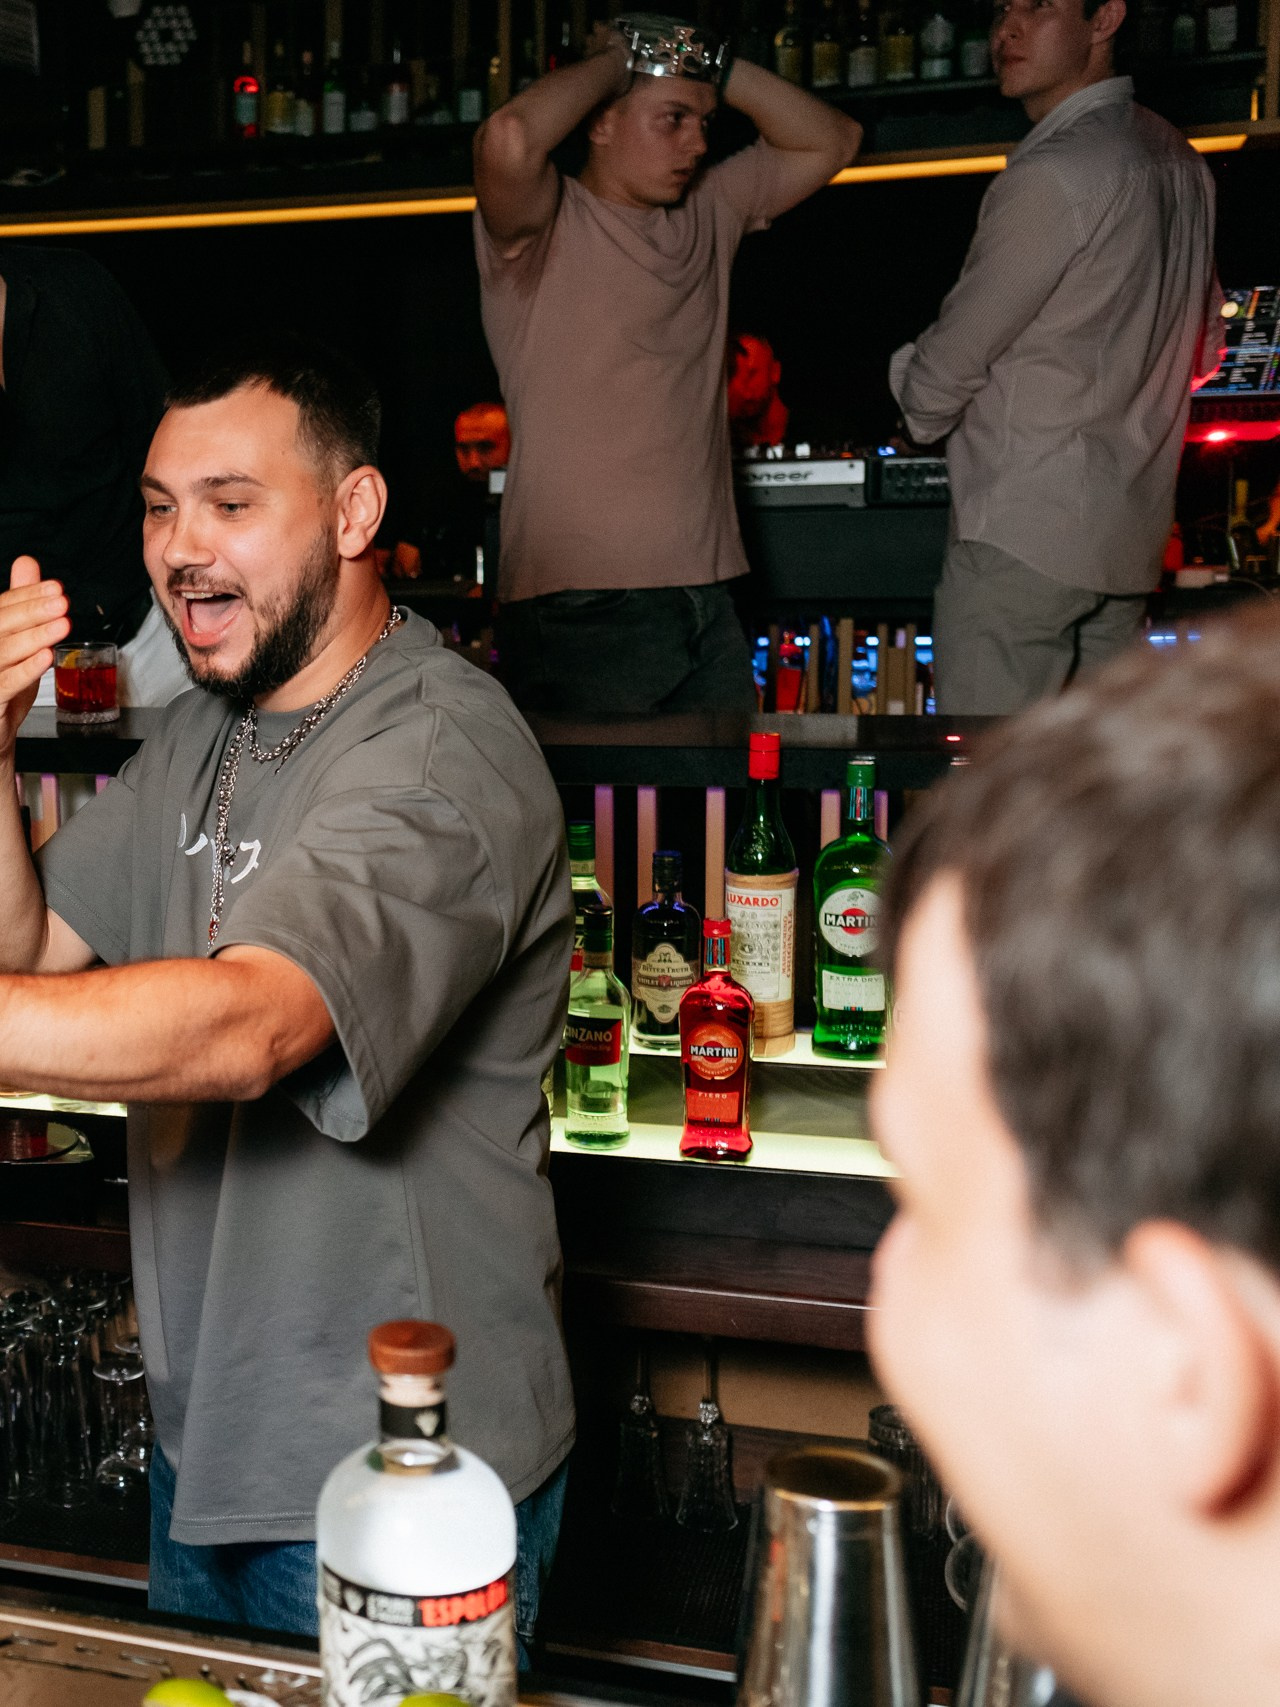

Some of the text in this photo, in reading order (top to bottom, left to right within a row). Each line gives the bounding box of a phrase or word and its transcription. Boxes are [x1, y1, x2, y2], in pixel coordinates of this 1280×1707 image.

[825, 914, 880, 928] MARTIN
[829, 975, 860, 983] EXTRA
[690, 1045, 738, 1058] MARTINI
[698, 1091, 728, 1100] FIERO
